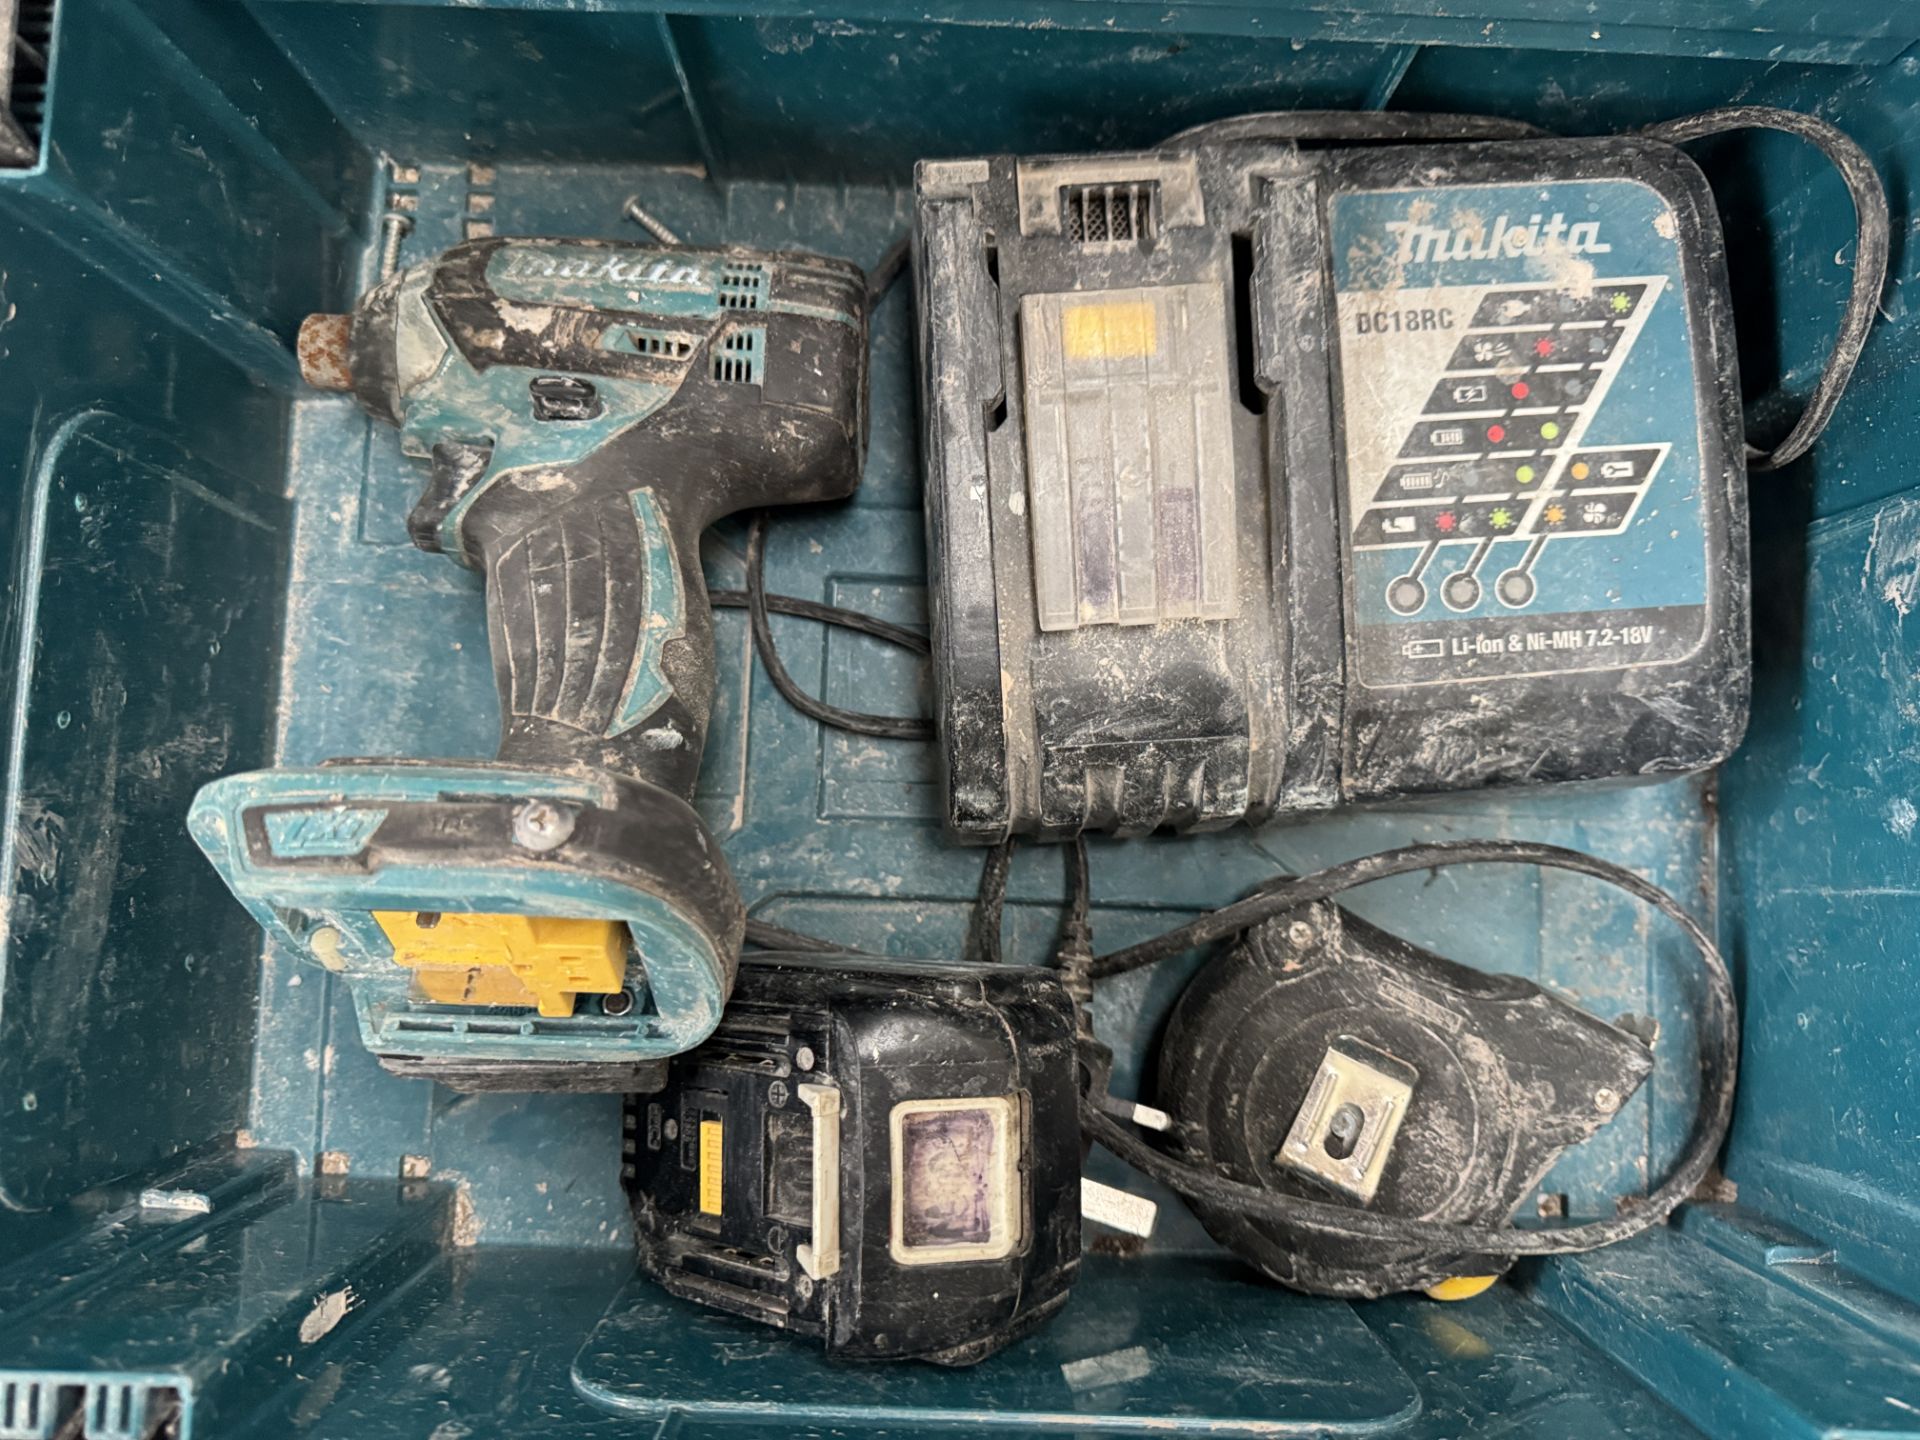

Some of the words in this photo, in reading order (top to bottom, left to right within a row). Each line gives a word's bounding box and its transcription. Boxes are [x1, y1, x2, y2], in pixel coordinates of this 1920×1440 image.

[1355, 307, 1454, 335] DC18RC
[1507, 634, 1523, 652] &
[1526, 630, 1583, 651] Ni-MH
[1585, 625, 1653, 647] 7.2-18V
